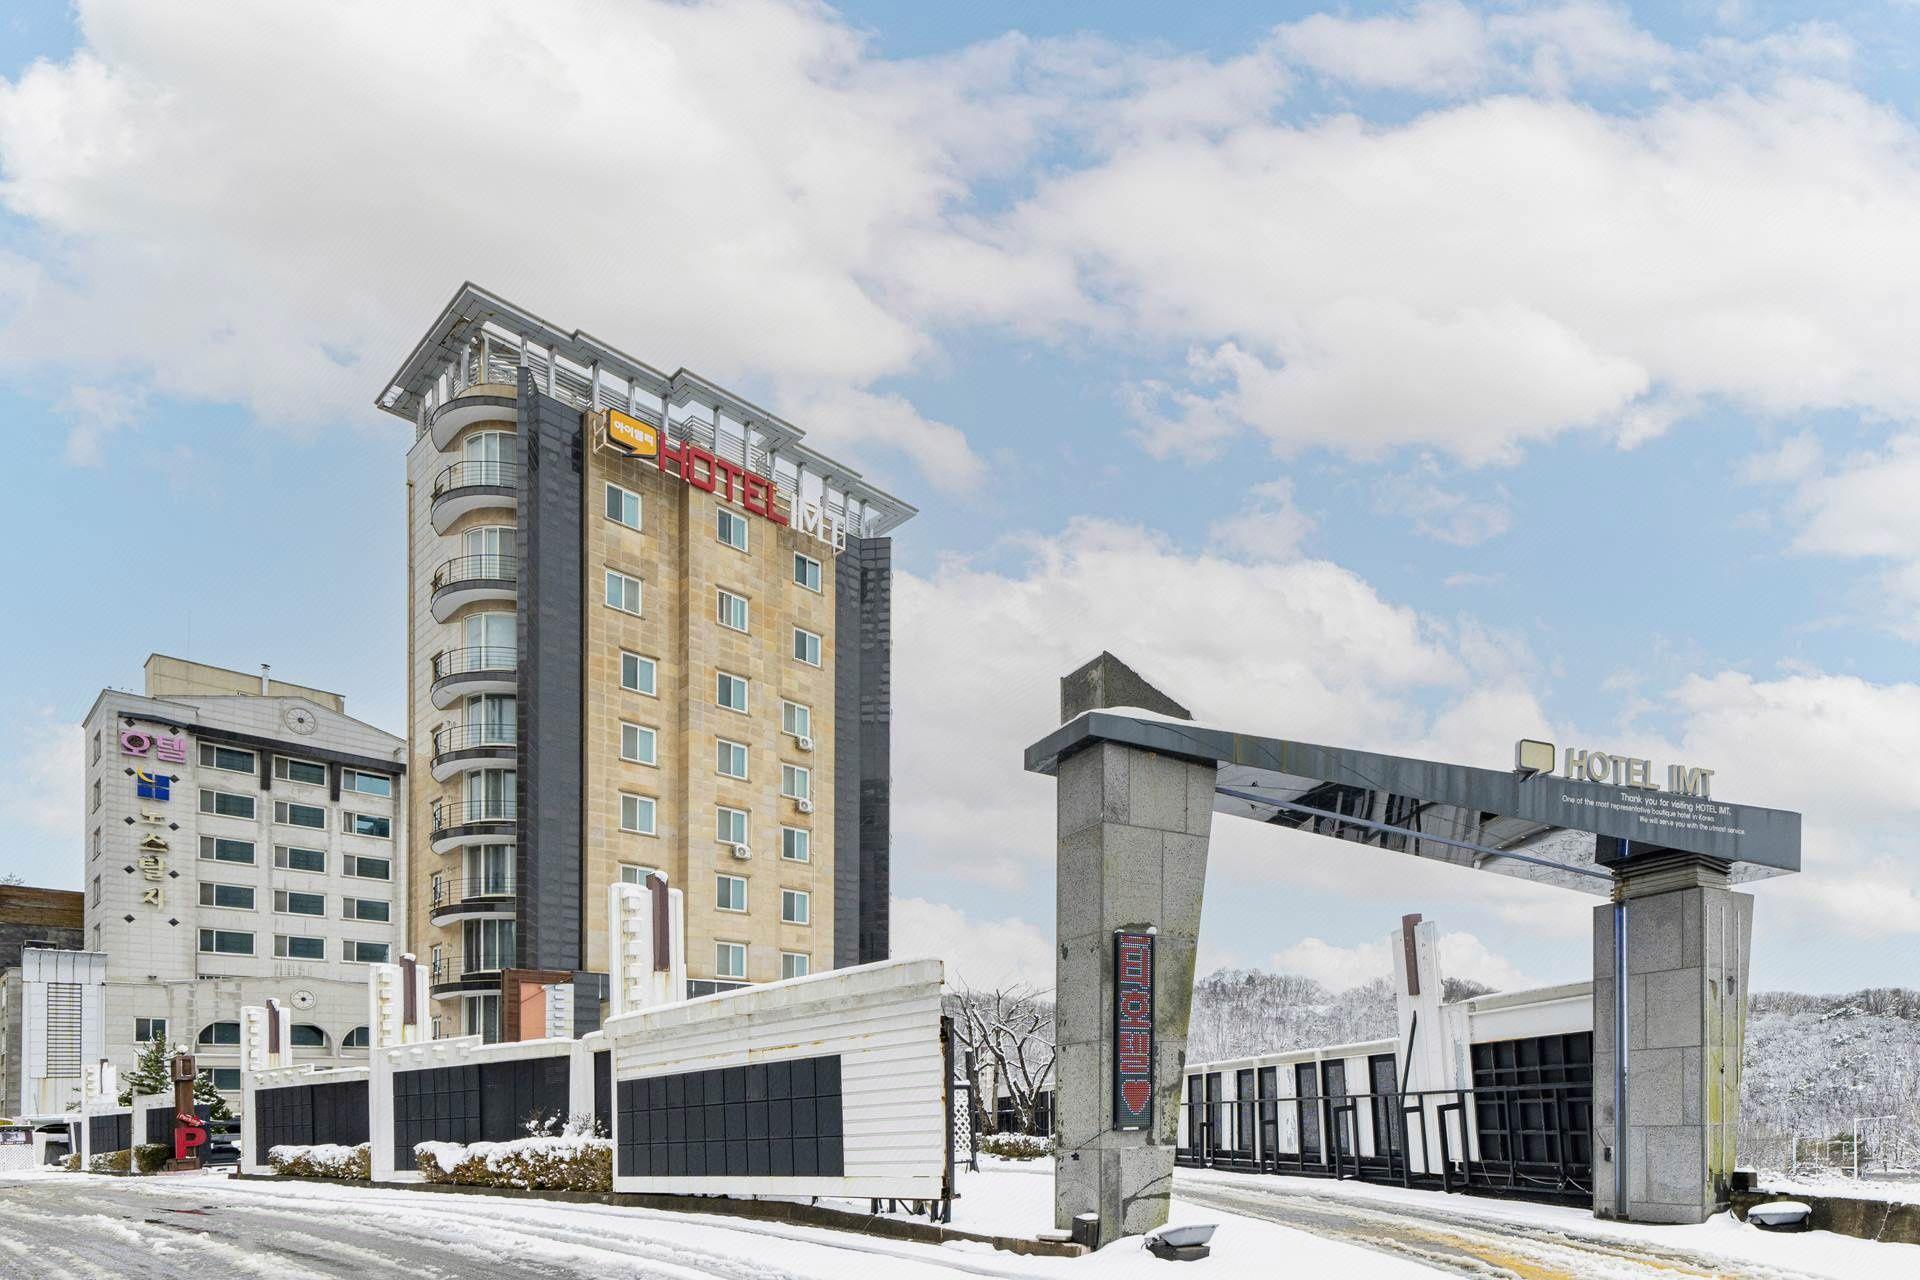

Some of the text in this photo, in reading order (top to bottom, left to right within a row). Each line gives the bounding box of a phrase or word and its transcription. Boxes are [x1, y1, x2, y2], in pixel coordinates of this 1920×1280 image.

[658, 431, 846, 551] HOTEL IMT
[120, 730, 187, 765] 호텔
[1564, 748, 1715, 797] HOTEL IMT
[1561, 794, 1576, 804] One
[1576, 797, 1583, 805] of
[1584, 798, 1595, 807] the
[1595, 800, 1610, 809] most
[1610, 802, 1651, 815] representative
[1651, 808, 1677, 818] boutique
[1677, 811, 1691, 820] hotel
[1620, 792, 1643, 804] Thank
[1660, 798, 1670, 807] for
[1671, 799, 1694, 813] visiting
[1695, 803, 1718, 814] HOTEL
[1649, 817, 1659, 825] will
[1675, 821, 1686, 829] you
[1686, 823, 1699, 831] with
[1699, 823, 1709, 832] the
[1708, 825, 1727, 834] utmost
[1120, 935, 1151, 1075] 티호텔
[175, 1127, 208, 1160] P
